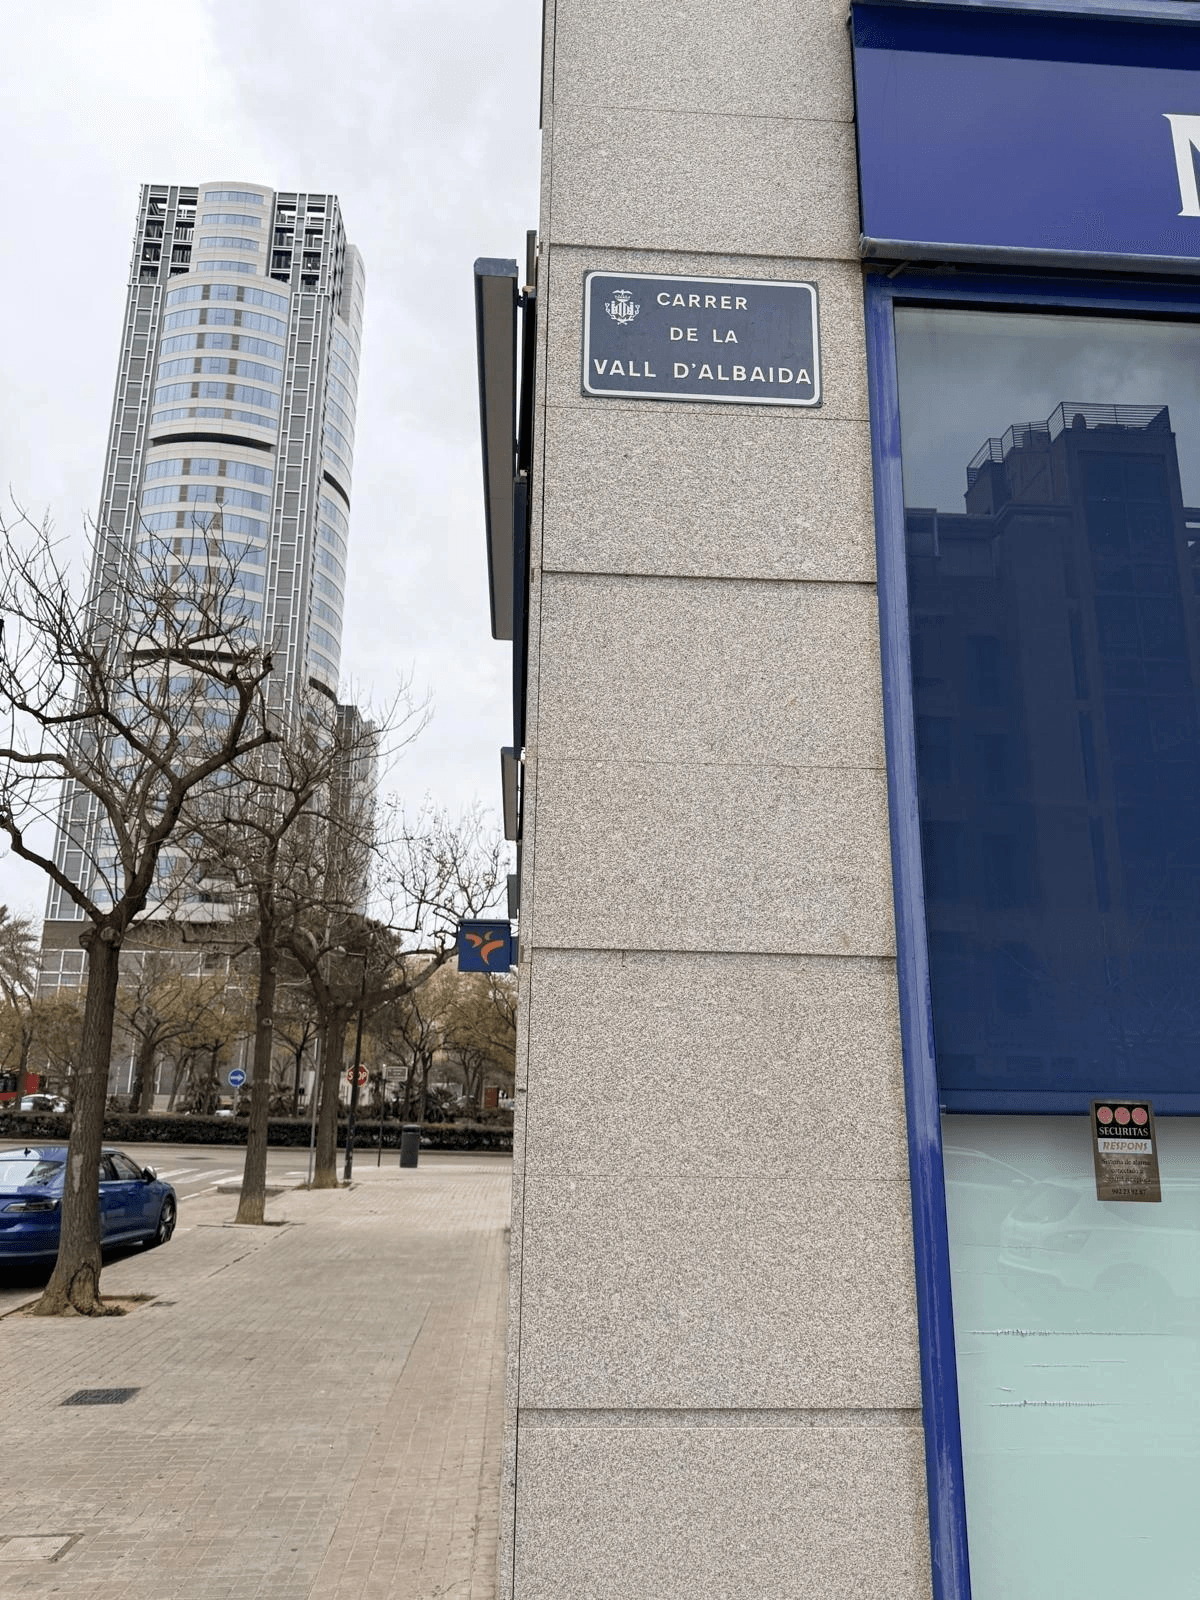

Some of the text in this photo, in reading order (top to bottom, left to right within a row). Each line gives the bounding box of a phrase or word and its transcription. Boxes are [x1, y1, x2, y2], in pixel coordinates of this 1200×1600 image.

[656, 292, 748, 311] CARRER
[670, 327, 739, 344] DE LA
[593, 358, 812, 385] VALL D'ALBAIDA
[1098, 1126, 1149, 1137] SECURITAS
[1102, 1141, 1148, 1151] RESPONS
